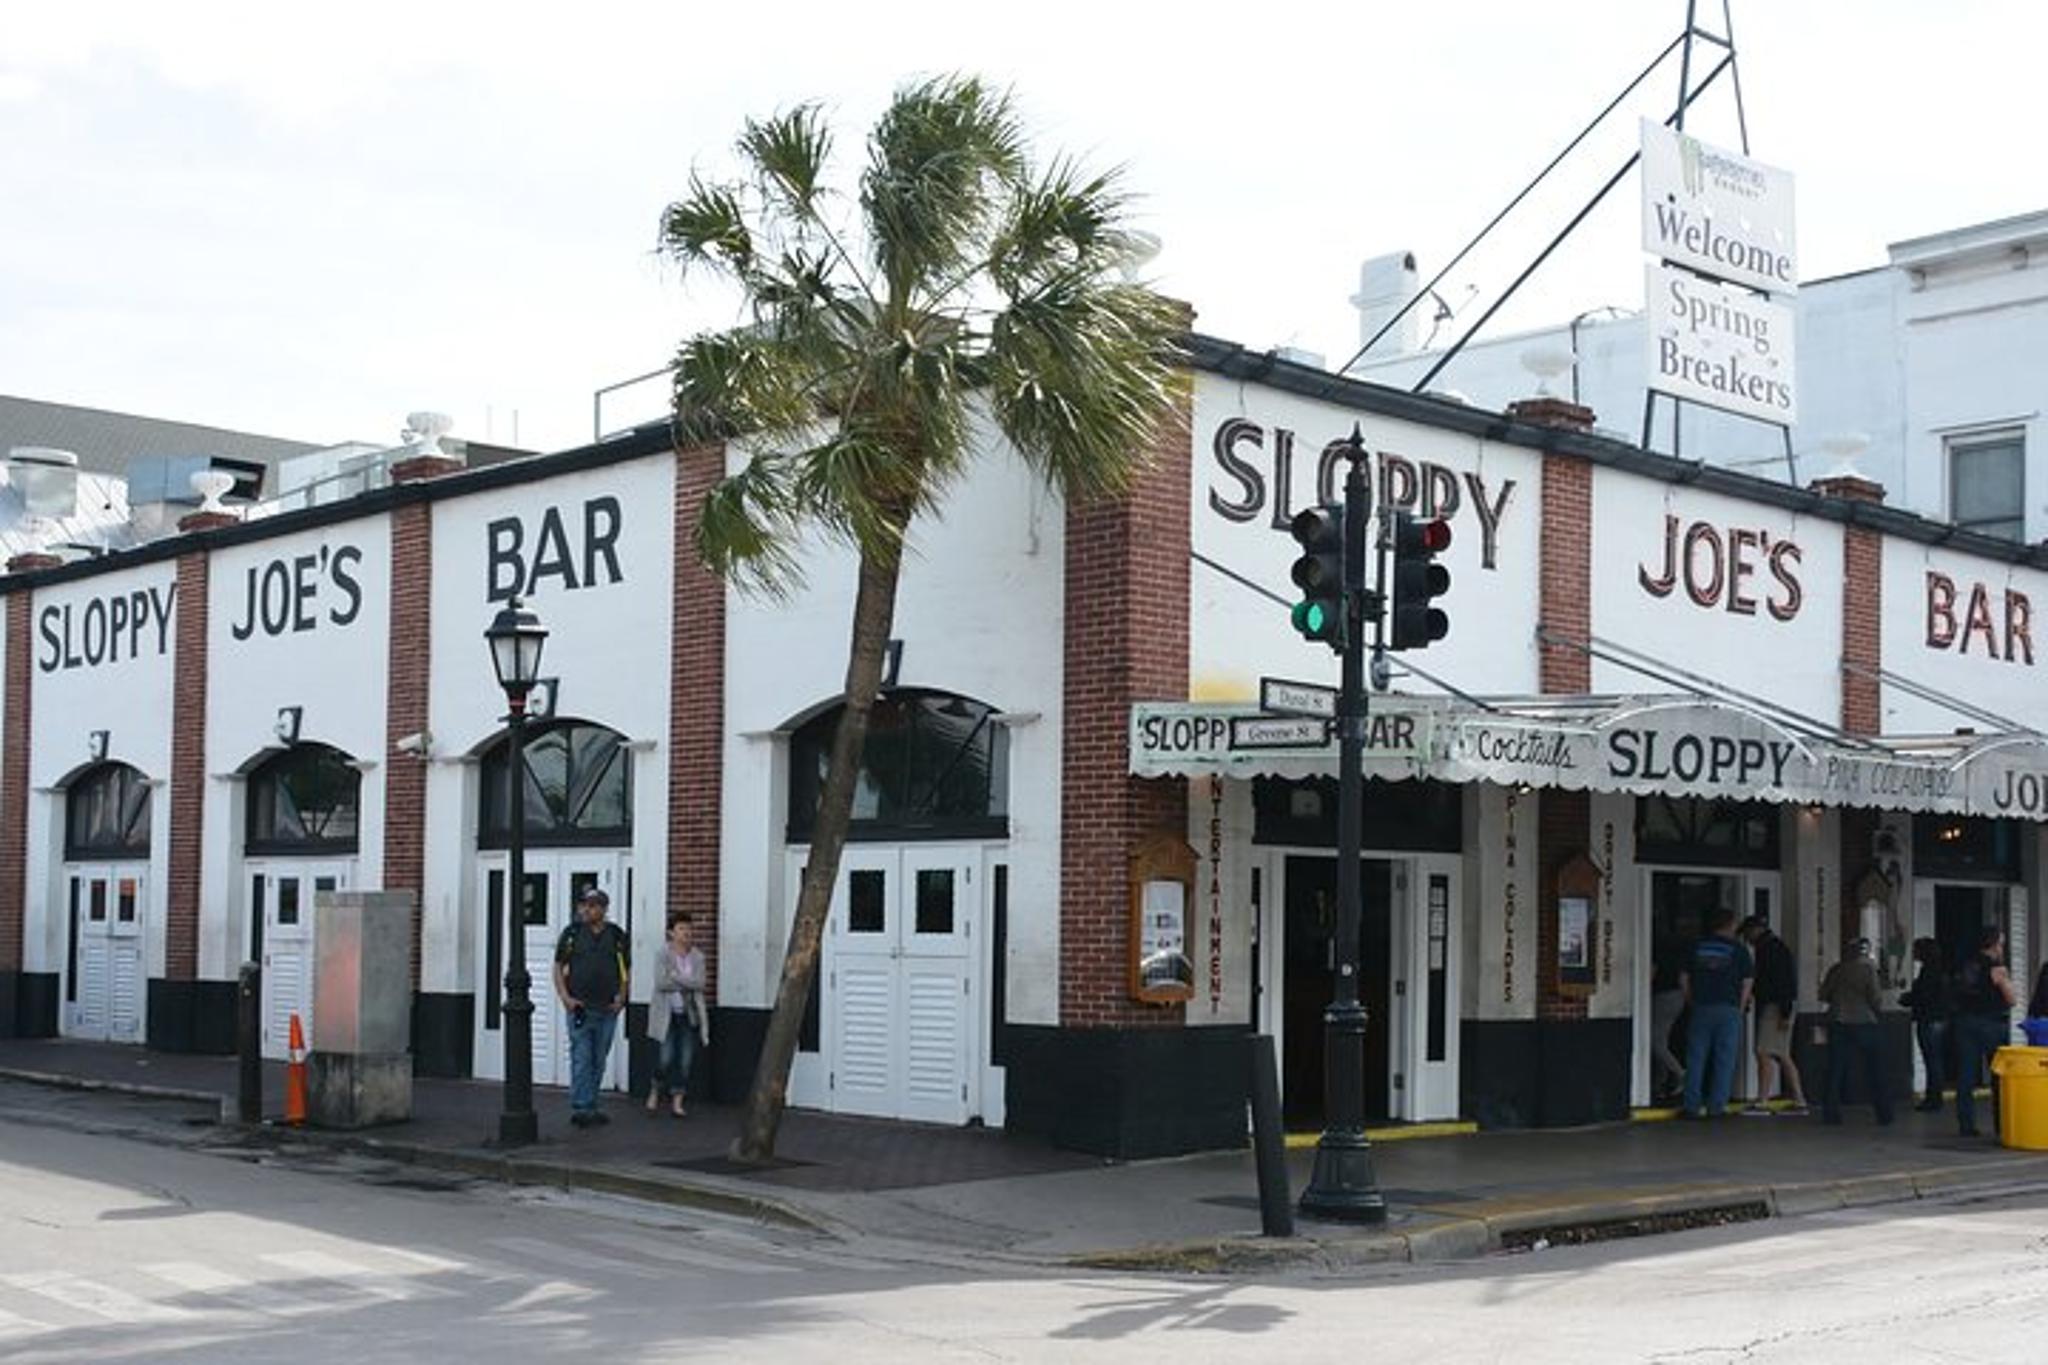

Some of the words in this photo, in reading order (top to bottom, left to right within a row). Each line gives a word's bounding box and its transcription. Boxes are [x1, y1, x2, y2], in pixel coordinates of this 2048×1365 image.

[1655, 201, 1791, 282] Welcome
[1670, 280, 1770, 354] Spring
[1659, 336, 1791, 410] Breakers
[1209, 417, 1516, 569] SLOPPY
[1638, 514, 1802, 622] JOE'S
[1924, 570, 2035, 667] BAR
[39, 582, 177, 673] SLOPPY
[232, 545, 362, 641] JOE'S
[487, 496, 624, 603] BAR
[1142, 715, 1228, 751] SLOPP
[1367, 714, 1416, 749] AR
[1478, 728, 1575, 769] Cocktails
[1607, 728, 1796, 787] SLOPPY
[1210, 778, 1222, 1014] NTERTAINMENT
